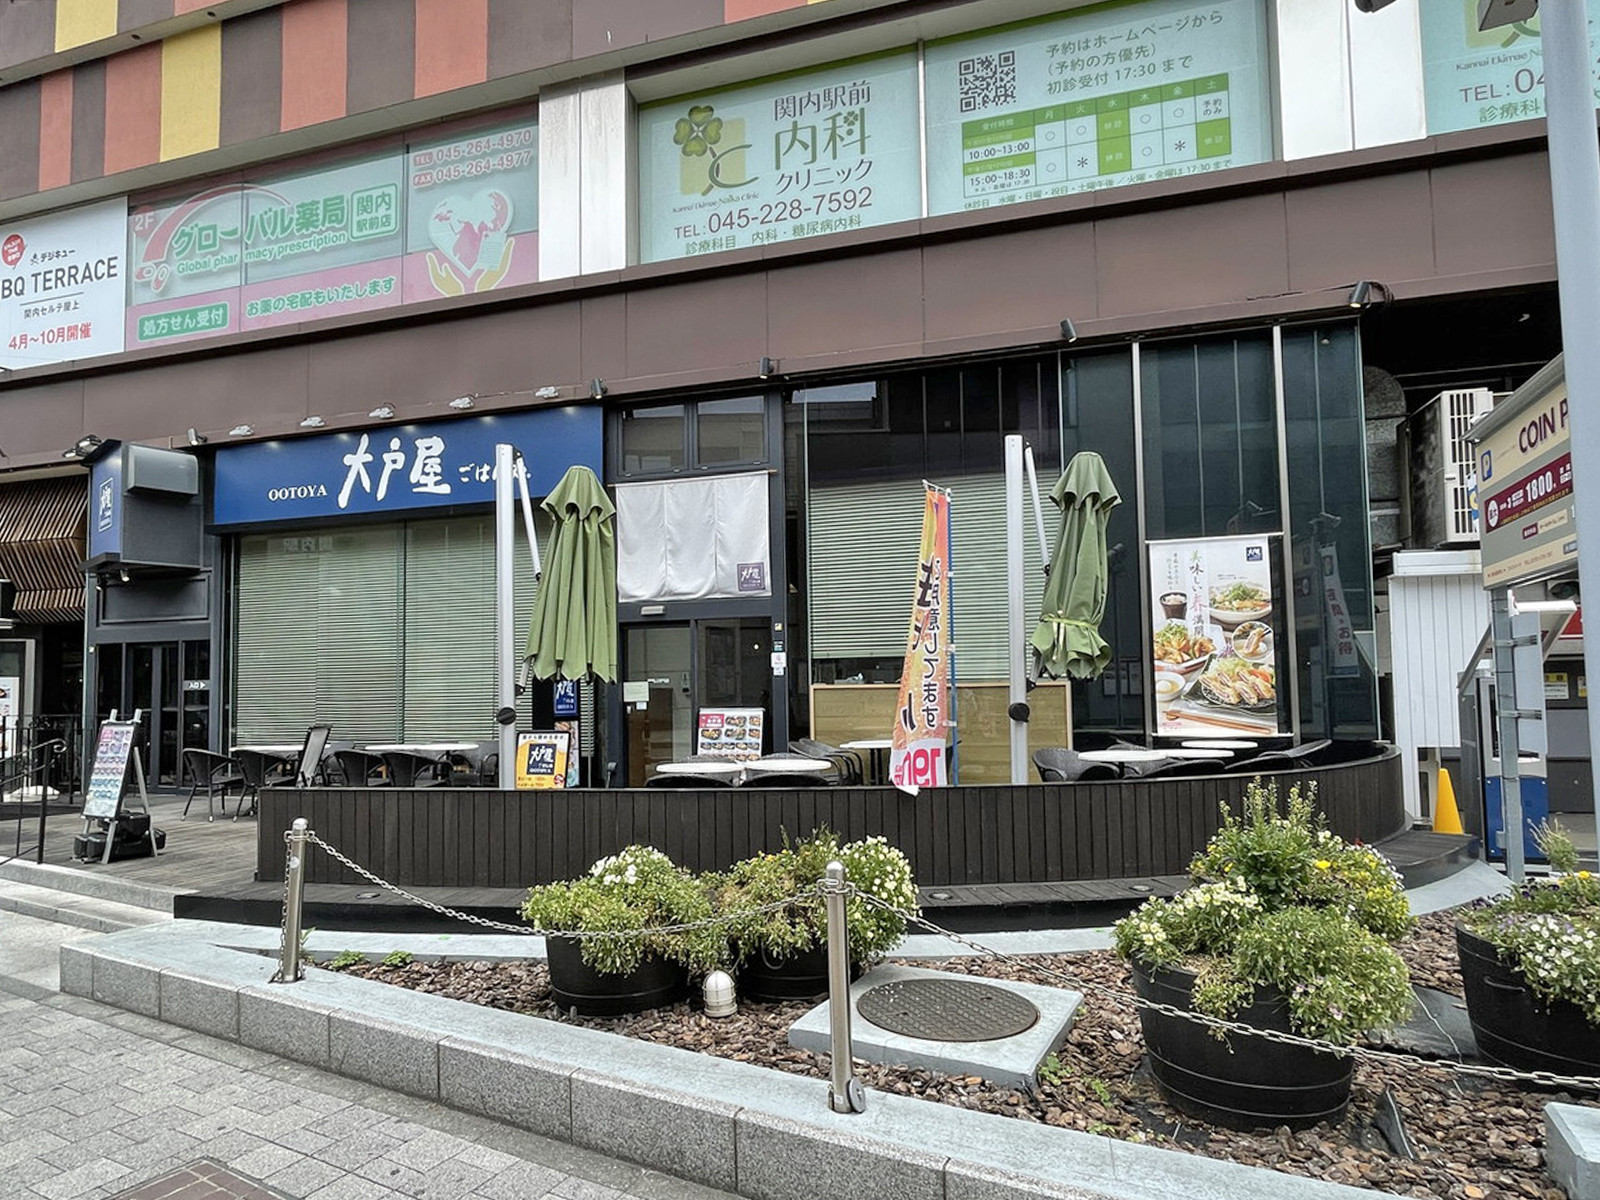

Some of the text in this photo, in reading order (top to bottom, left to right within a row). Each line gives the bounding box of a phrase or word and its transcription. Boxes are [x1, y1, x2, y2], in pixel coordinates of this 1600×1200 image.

[1046, 10, 1223, 59] 予約はホームページから
[1047, 55, 1193, 95] 初診受付 17:30 まで
[774, 80, 871, 122] 関内駅前
[436, 130, 532, 162] 045-264-4970
[774, 107, 872, 171] 内科
[414, 150, 532, 185] FAX 045-264-4977
[775, 158, 873, 195] クリニック
[355, 213, 393, 233] 駅前店
[356, 191, 392, 216] 関内
[708, 187, 873, 233] 045-228-7592
[172, 194, 346, 258] グローバル薬局
[685, 235, 737, 256] 診療科目
[176, 257, 210, 275] Global
[276, 231, 346, 260] prescription
[31, 256, 119, 294] TERRACE
[246, 276, 395, 318] お薬の宅配もいたします
[142, 307, 224, 337] 処方せん受付
[1518, 407, 1556, 454] COIN
[337, 433, 452, 509] 大戸屋
[268, 484, 328, 502] OOTOYA
